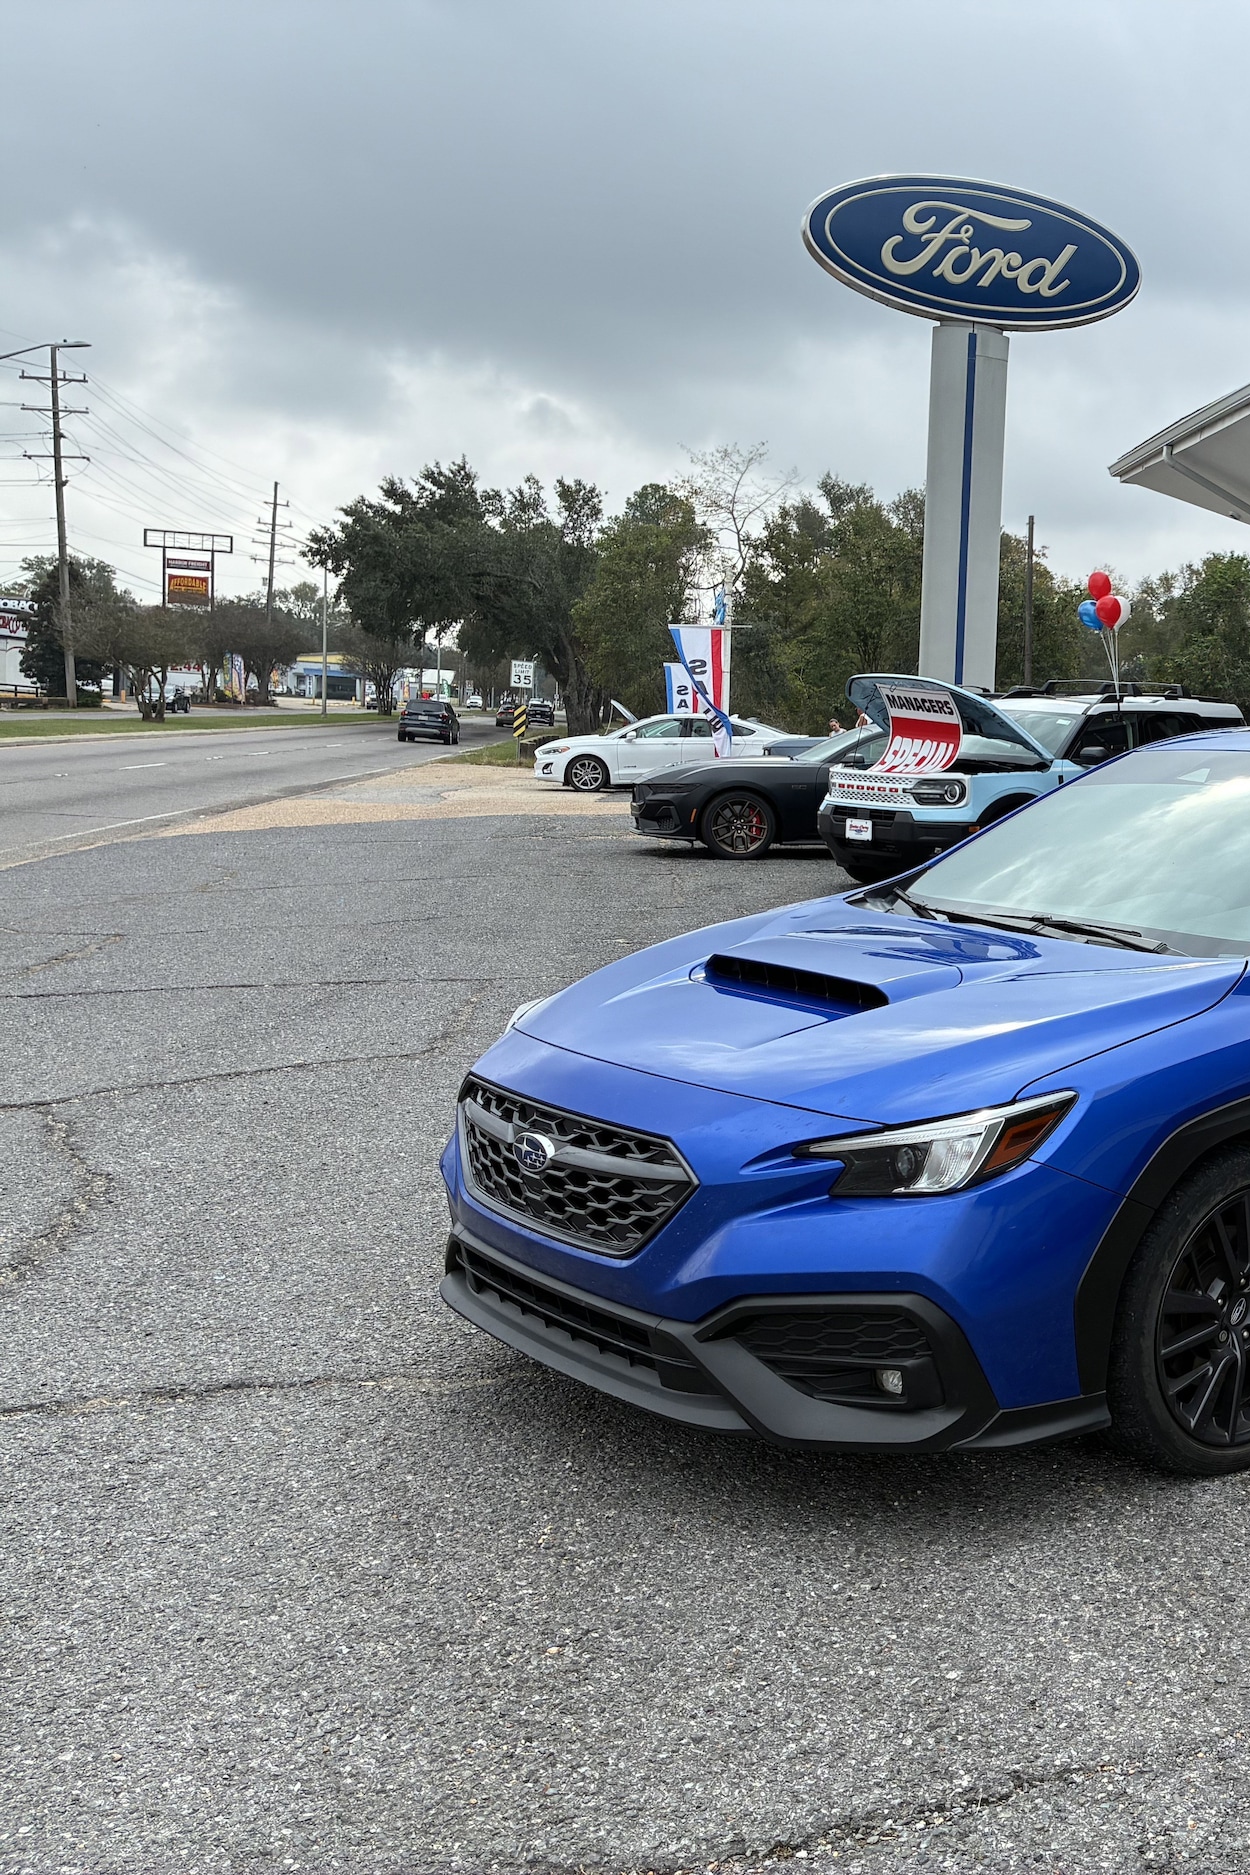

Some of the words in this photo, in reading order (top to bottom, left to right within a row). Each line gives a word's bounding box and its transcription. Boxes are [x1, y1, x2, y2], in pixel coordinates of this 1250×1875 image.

[880, 200, 1078, 297] Ford
[169, 577, 207, 593] AFFORDABLE
[513, 674, 531, 685] 35
[885, 694, 954, 716] MANAGERS
[872, 735, 955, 773] SPECIAL
[838, 783, 899, 793] BRONCO
